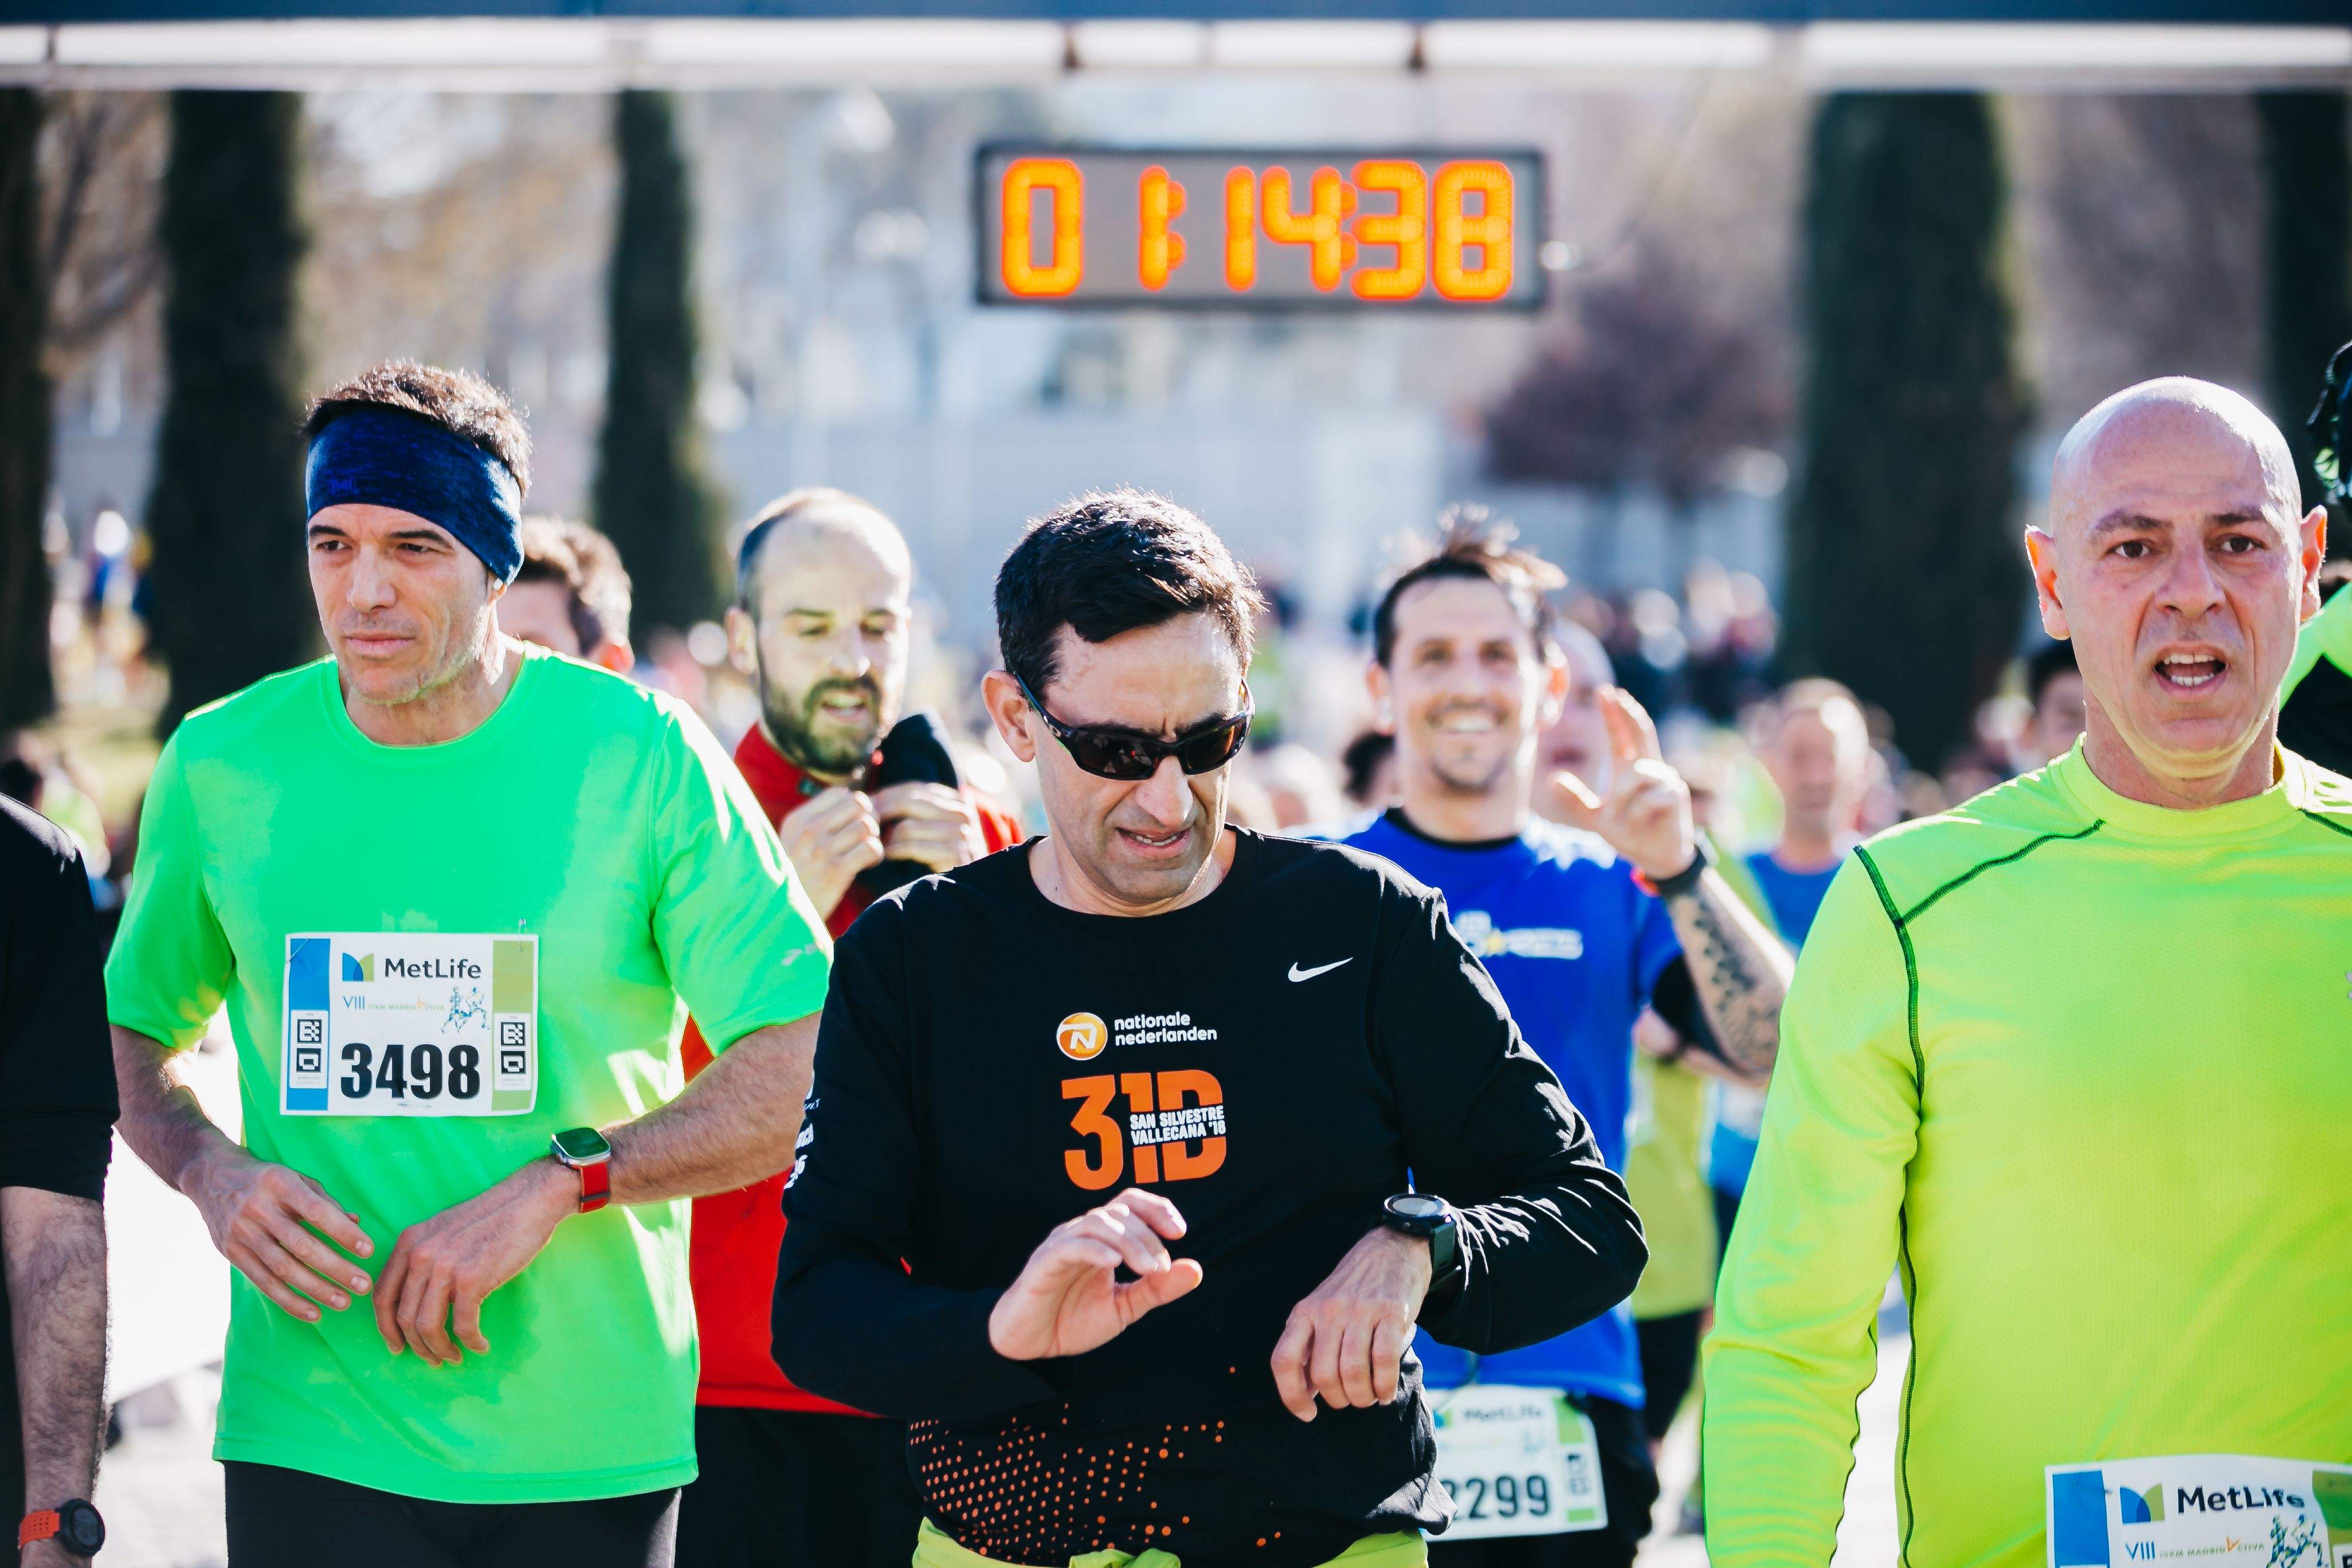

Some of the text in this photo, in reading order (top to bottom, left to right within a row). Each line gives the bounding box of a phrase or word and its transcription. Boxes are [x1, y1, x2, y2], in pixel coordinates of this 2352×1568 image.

[385, 958, 481, 979] MetLife
[343, 996, 365, 1010] VIII
[1114, 1011, 1190, 1031] nationale
[1115, 1026, 1217, 1046] nederlanden
[340, 1043, 480, 1100] 3498
[1130, 1106, 1225, 1130] SAN SILVESTRE
[1061, 1069, 1226, 1190] 31D
[1131, 1120, 1226, 1146] VALLECANA '18
[2125, 1540, 2155, 1561] VIII
